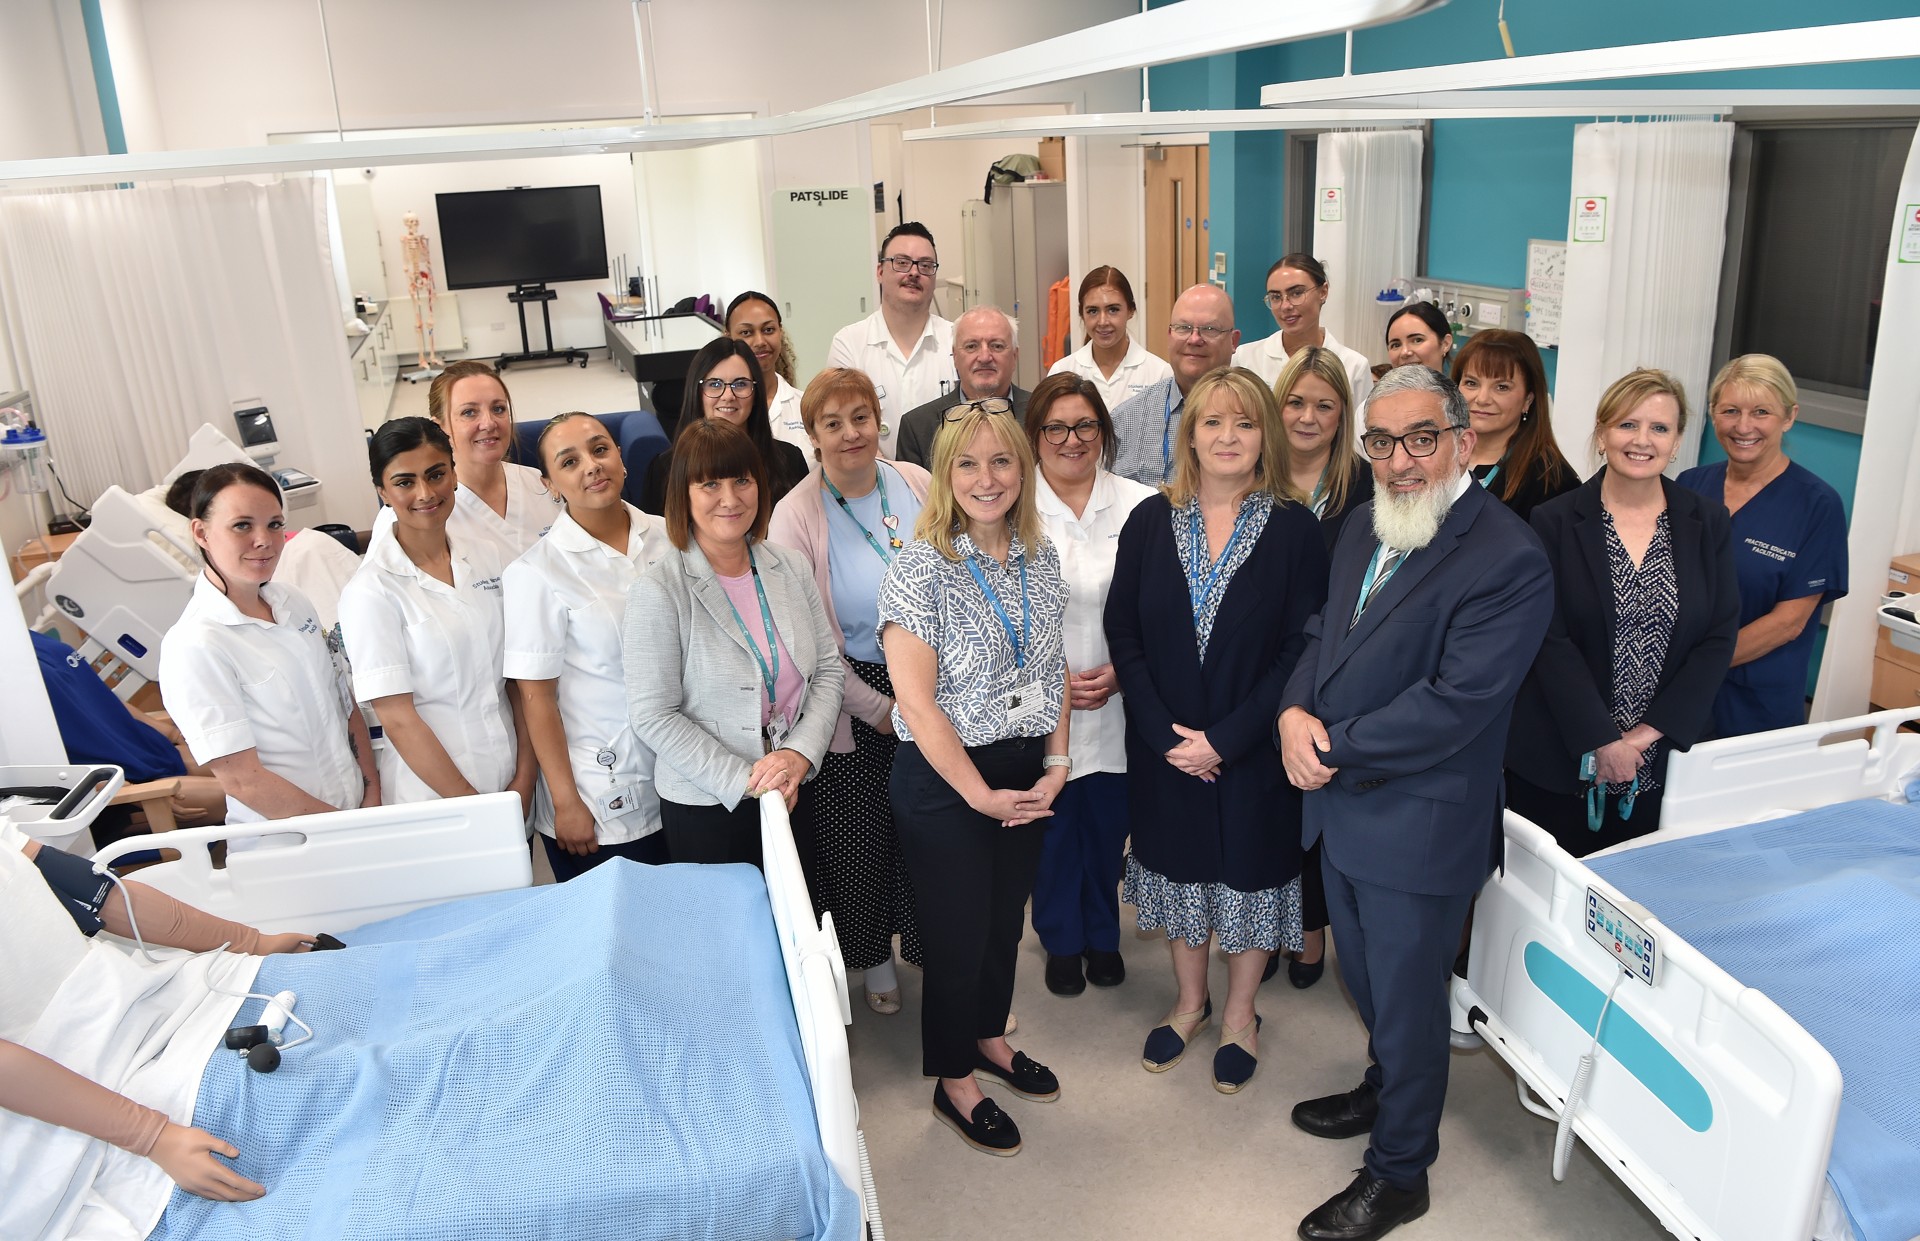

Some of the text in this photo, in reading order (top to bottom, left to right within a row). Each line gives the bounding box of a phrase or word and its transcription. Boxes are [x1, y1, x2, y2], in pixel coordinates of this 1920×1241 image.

[790, 190, 849, 202] PATSLIDE
[1744, 537, 1797, 558] PRACTICE EDUCATIO
[1751, 546, 1786, 562] FACILITATOR
